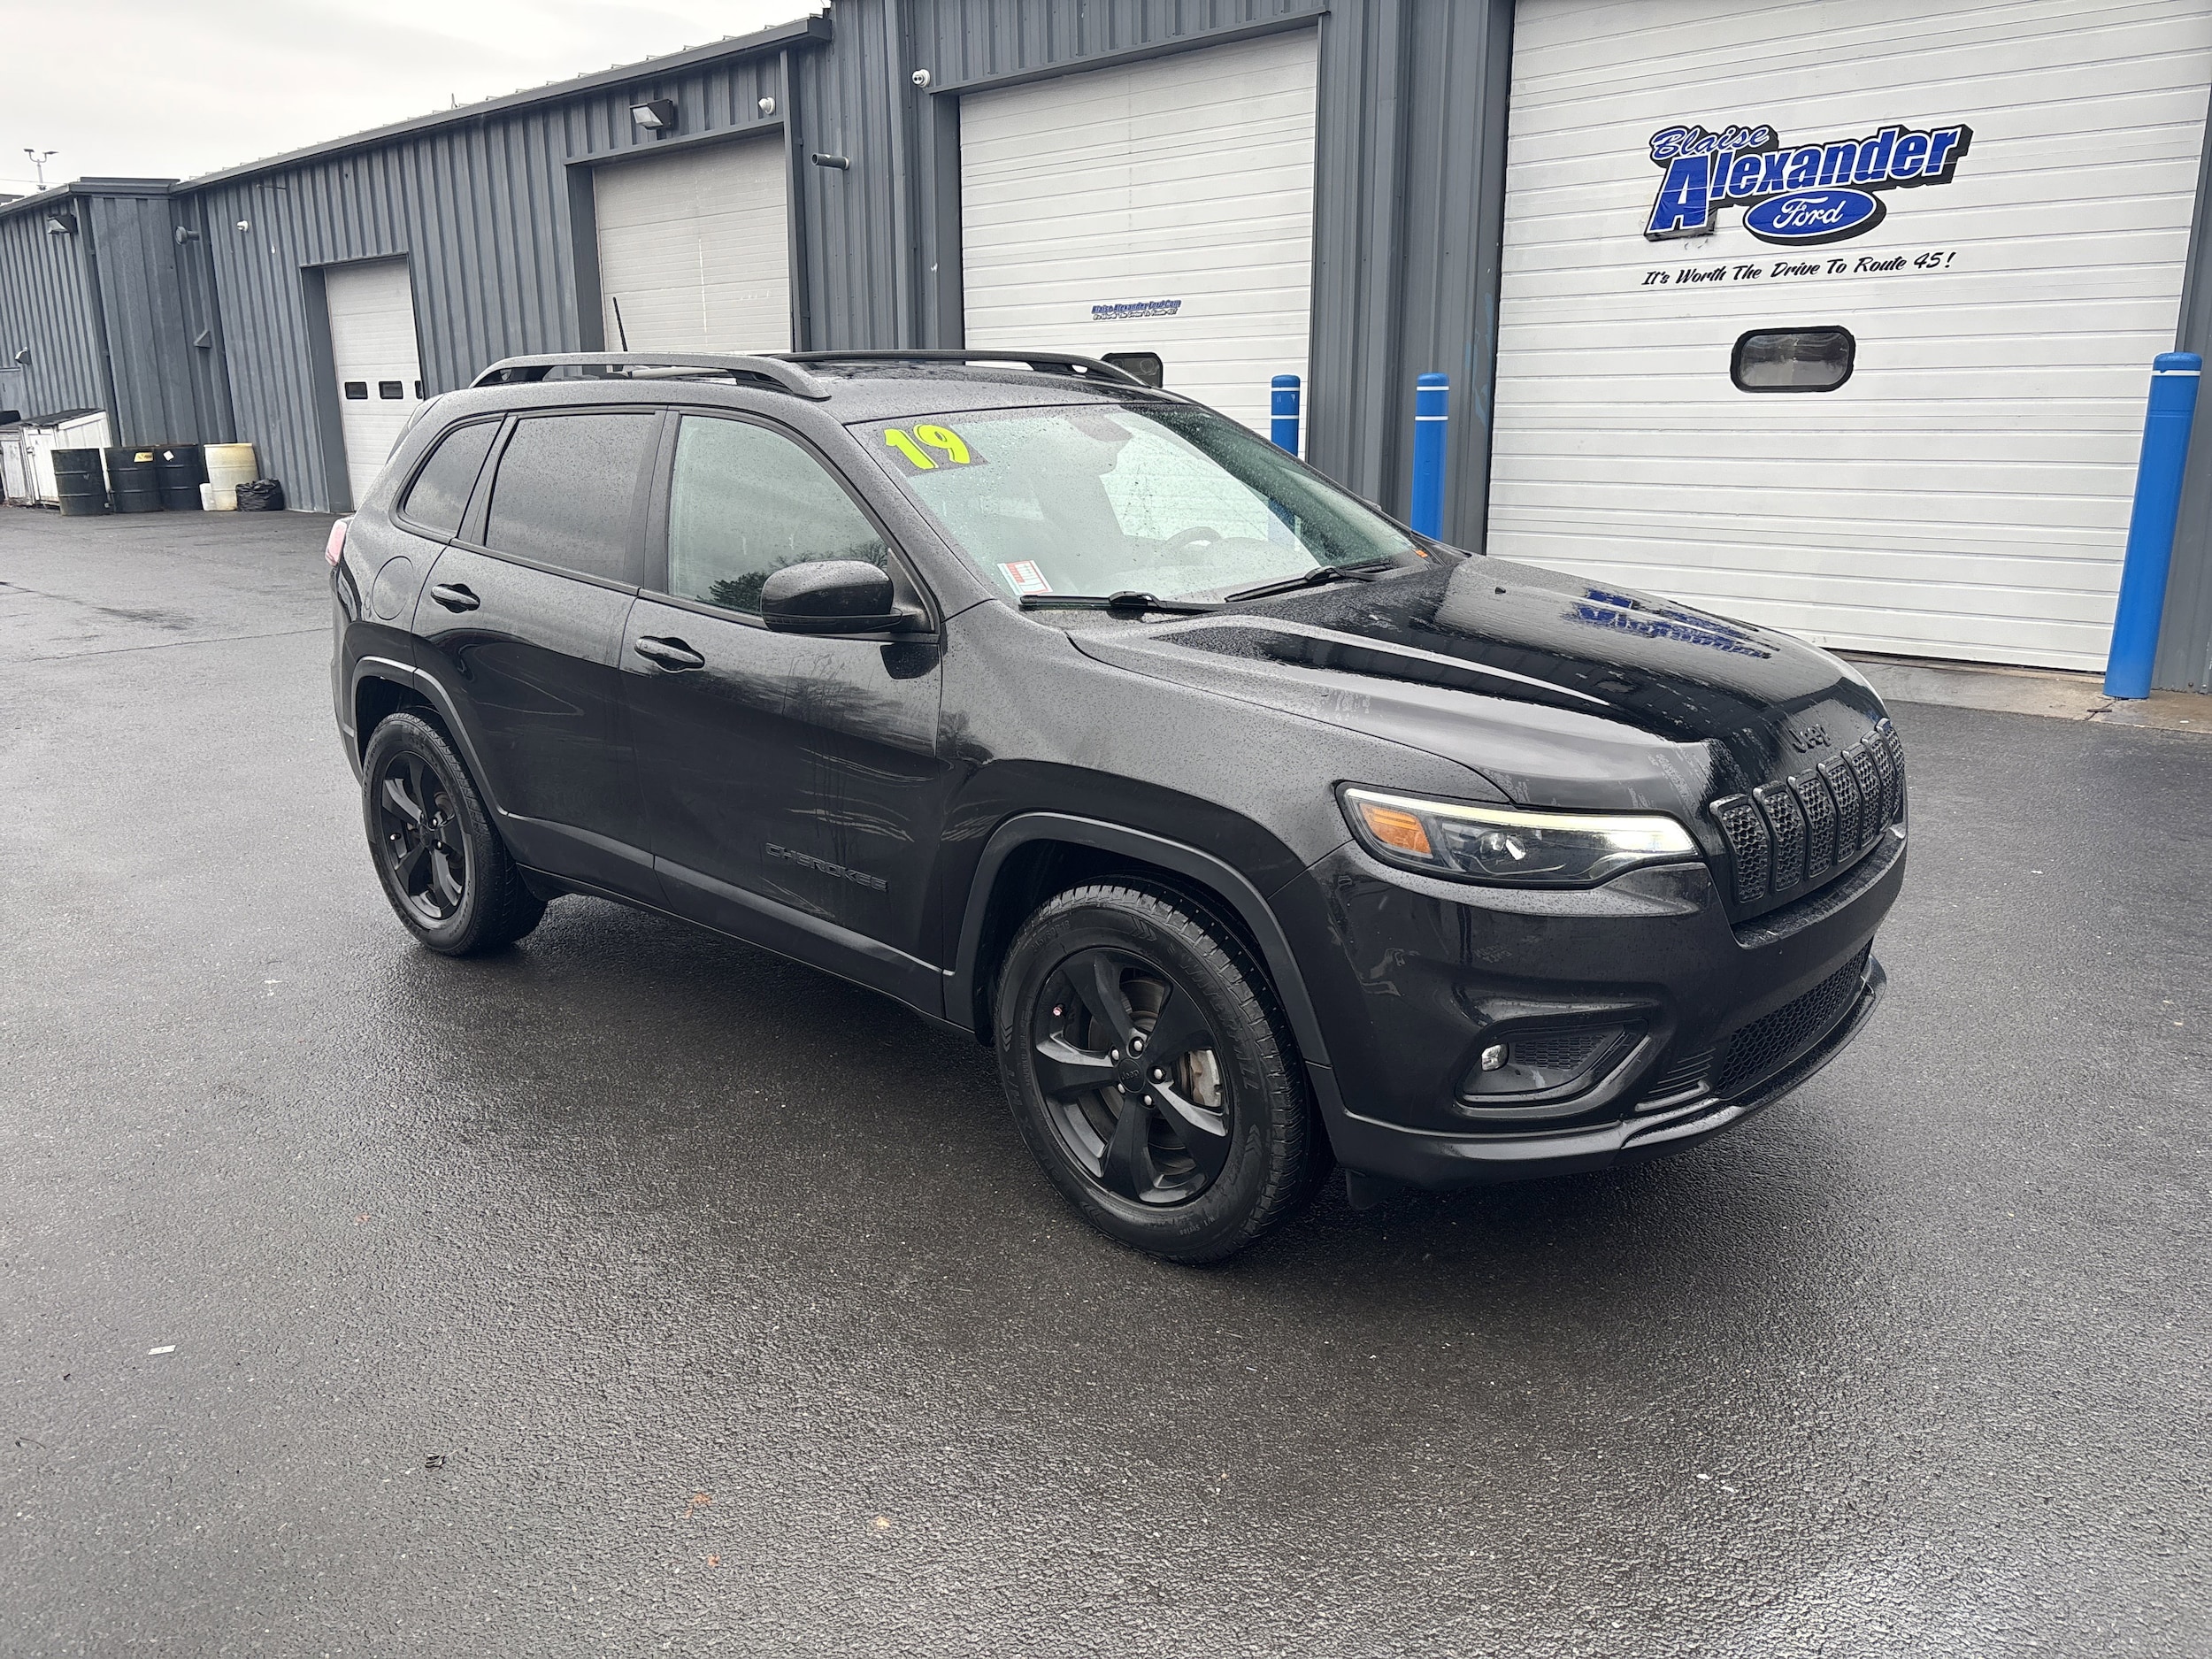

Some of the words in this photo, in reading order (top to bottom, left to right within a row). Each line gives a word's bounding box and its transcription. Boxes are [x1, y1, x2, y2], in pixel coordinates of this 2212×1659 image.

[1651, 124, 1770, 161] Blaise
[1647, 127, 1964, 234] Alexander
[1771, 196, 1844, 230] Ford
[1641, 271, 1670, 286] It's
[1676, 265, 1728, 284] Worth
[1732, 264, 1763, 281] The
[1770, 262, 1821, 280] Drive
[1827, 258, 1848, 275] To
[1854, 256, 1908, 273] Route
[1913, 251, 1957, 270] 45!
[884, 424, 971, 470] 19
[1789, 723, 1832, 753] Jeep
[765, 842, 888, 892] CHEROKEE
